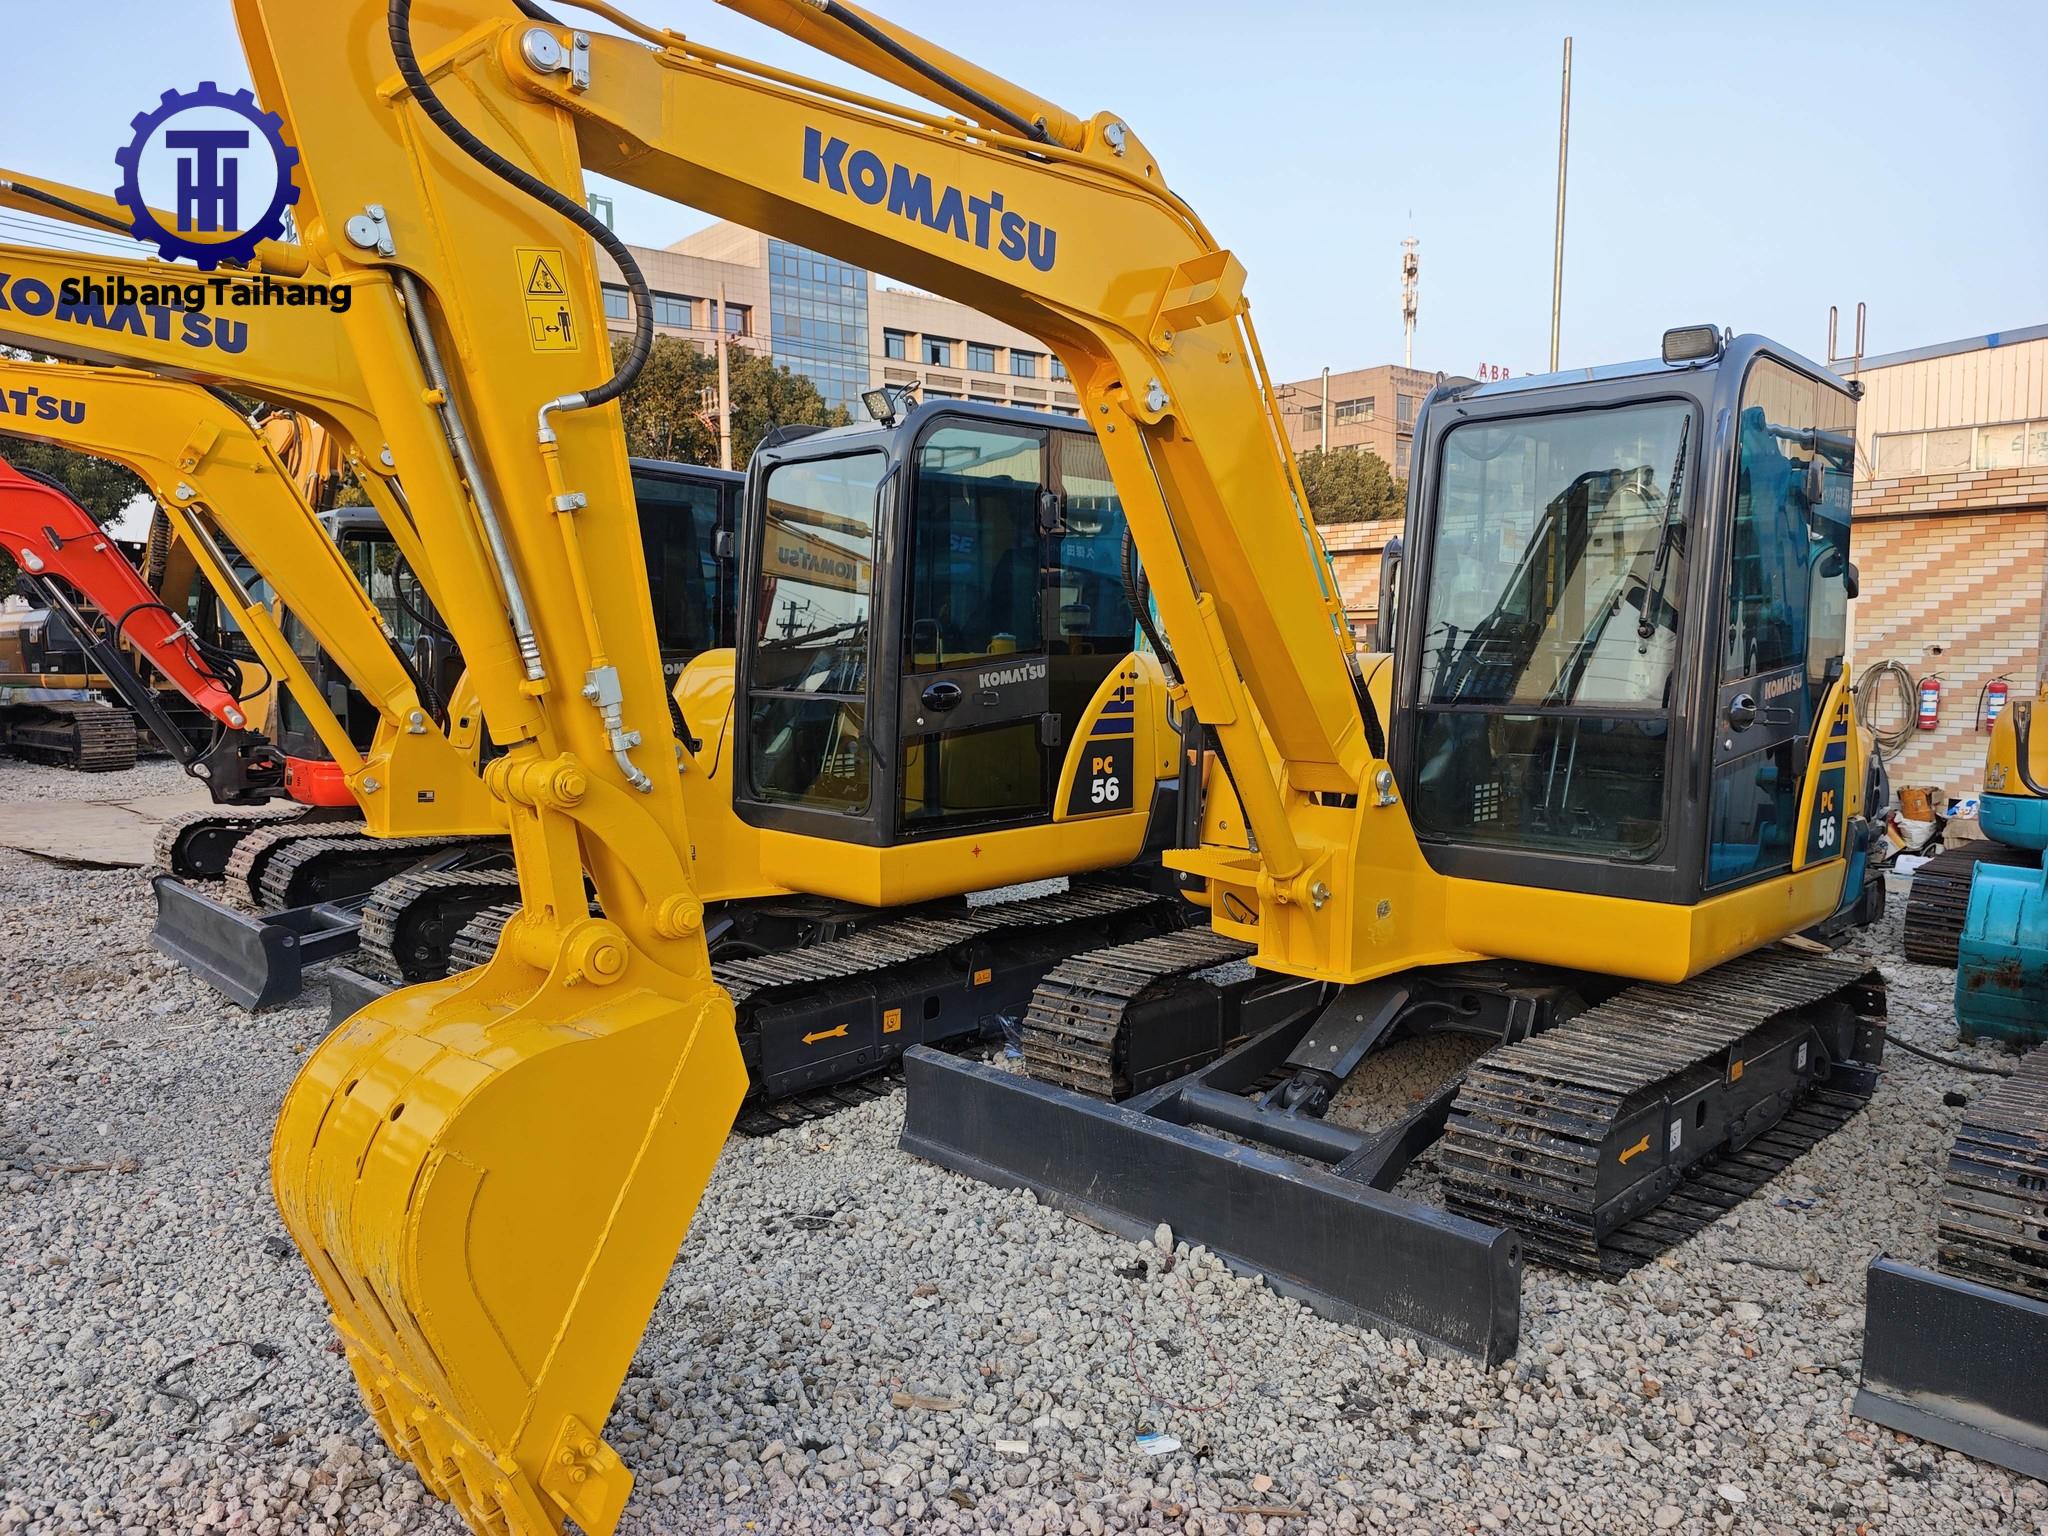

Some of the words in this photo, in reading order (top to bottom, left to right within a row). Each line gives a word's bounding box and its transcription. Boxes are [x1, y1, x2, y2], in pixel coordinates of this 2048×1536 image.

[803, 126, 1056, 272] KOMATSU
[979, 663, 1046, 688] KOMATSU
[1764, 670, 1803, 700] KOMATSU
[1092, 756, 1113, 776] PC
[1091, 776, 1119, 804] 56
[1821, 790, 1834, 814] PC
[1818, 816, 1835, 849] 56
